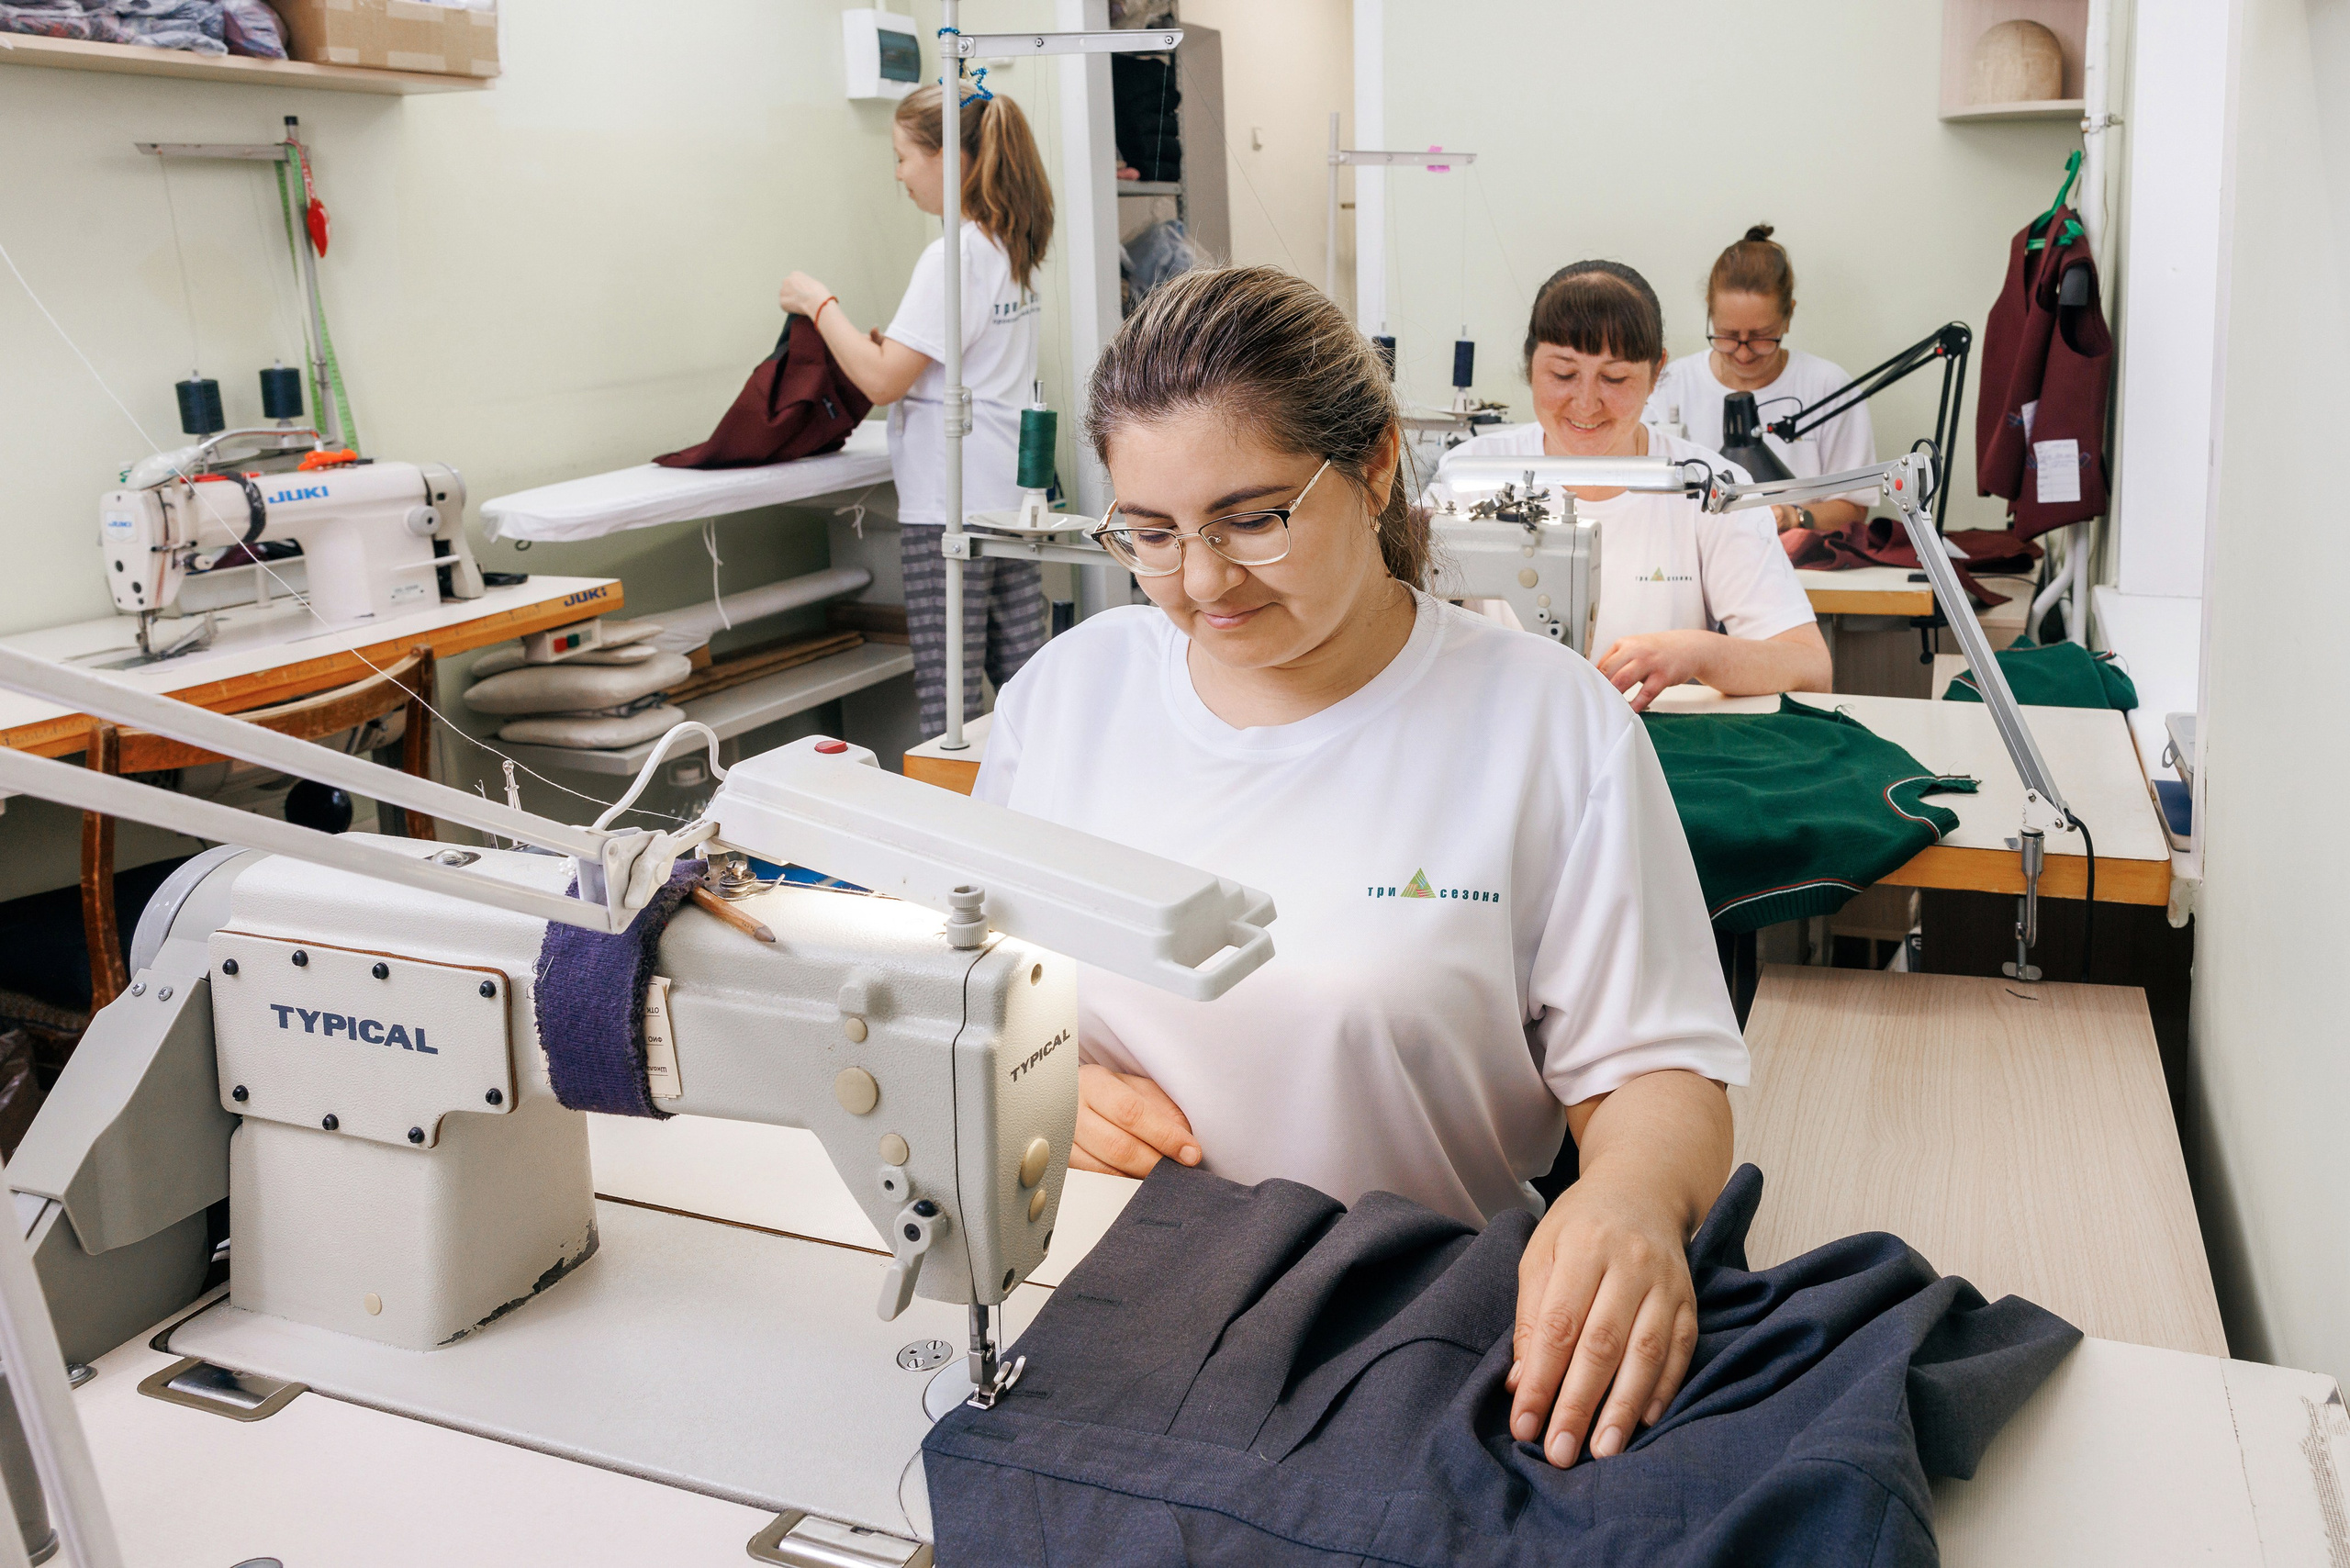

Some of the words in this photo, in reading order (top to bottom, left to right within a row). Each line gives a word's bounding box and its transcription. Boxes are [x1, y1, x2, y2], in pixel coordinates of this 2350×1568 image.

[267, 485, 330, 505] JUKI
[564, 587, 608, 607] JUKI
[1367, 887, 1396, 899] три
[1439, 888, 1500, 903] сезона
[270, 1003, 439, 1055] TYPICAL
[1010, 1028, 1071, 1083] TYPICAL
